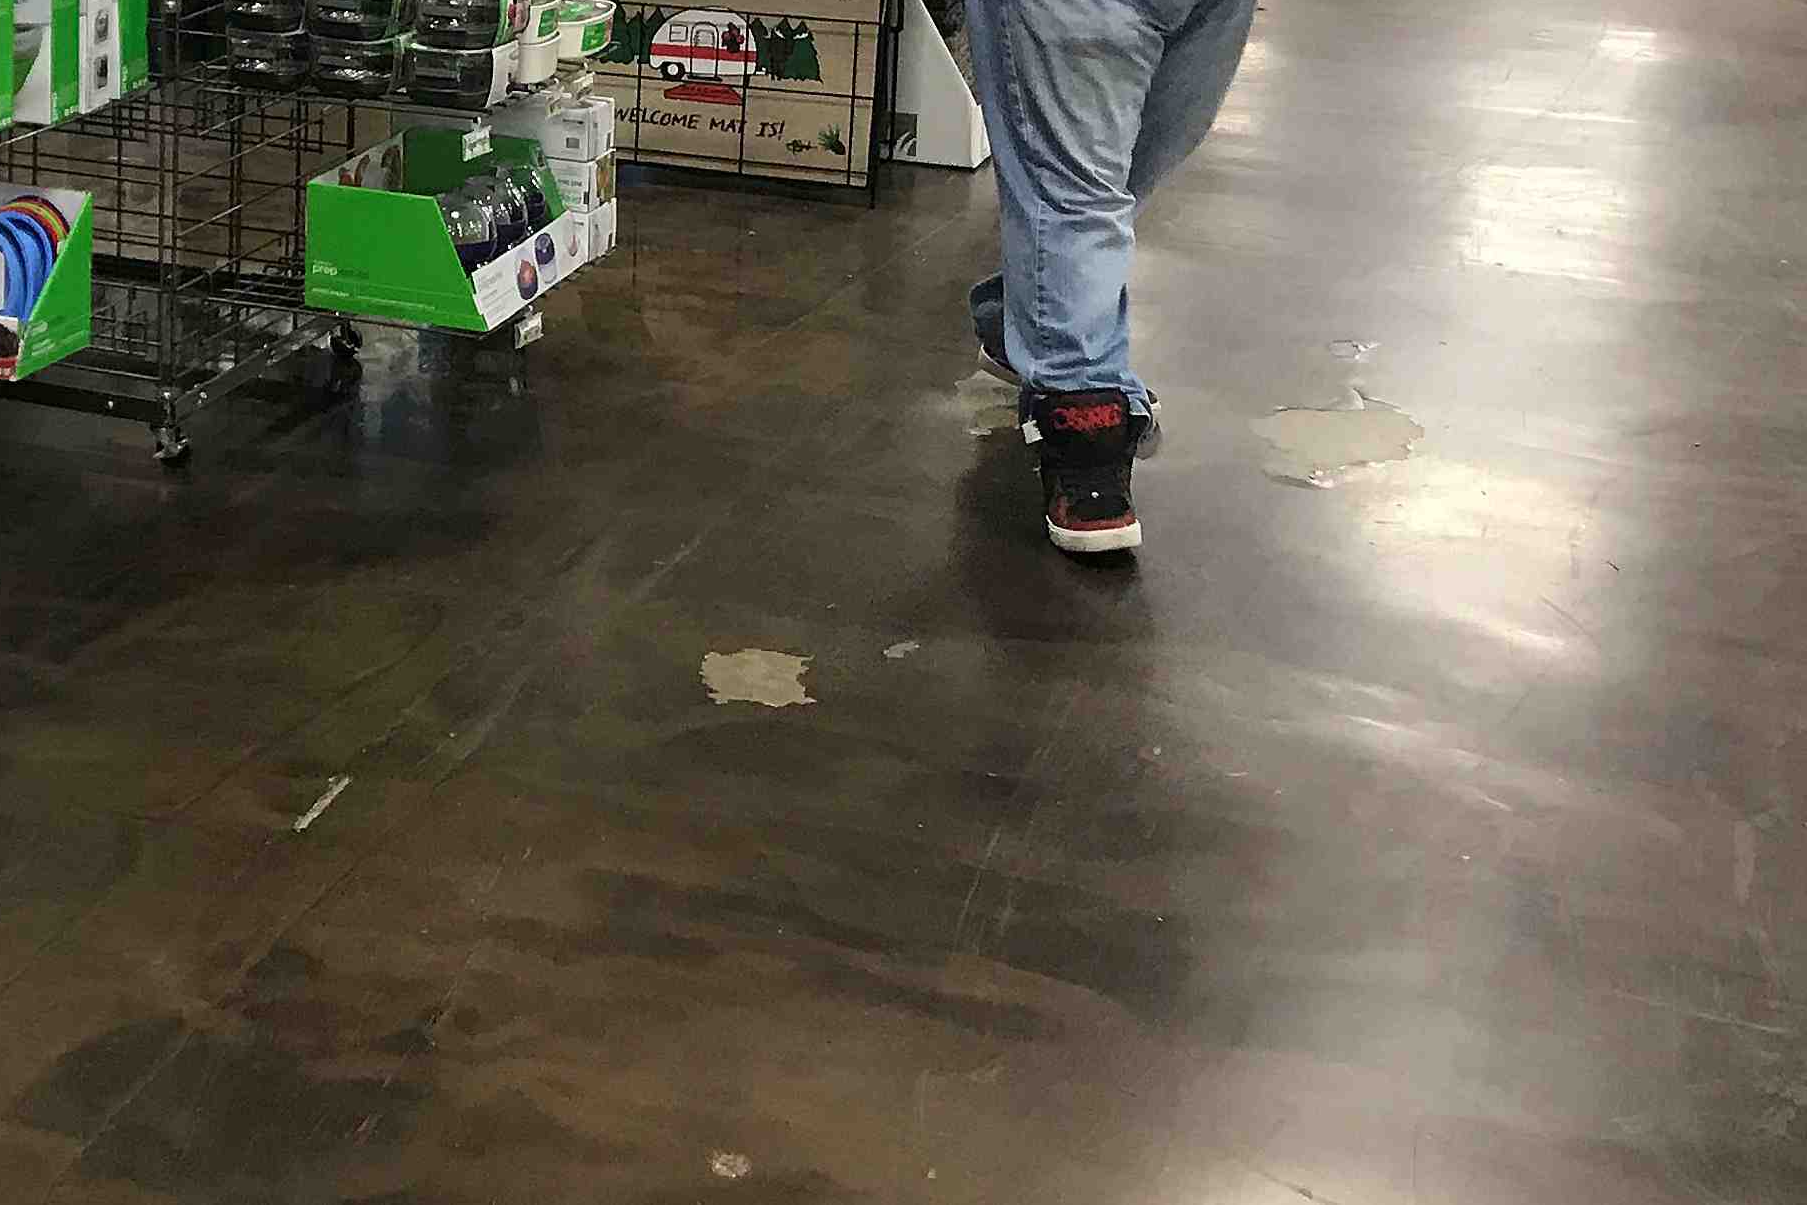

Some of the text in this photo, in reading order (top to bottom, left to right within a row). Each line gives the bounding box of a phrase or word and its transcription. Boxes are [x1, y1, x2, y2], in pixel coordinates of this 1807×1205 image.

[614, 105, 786, 140] WELCOME MAT IS!
[312, 264, 338, 276] prep
